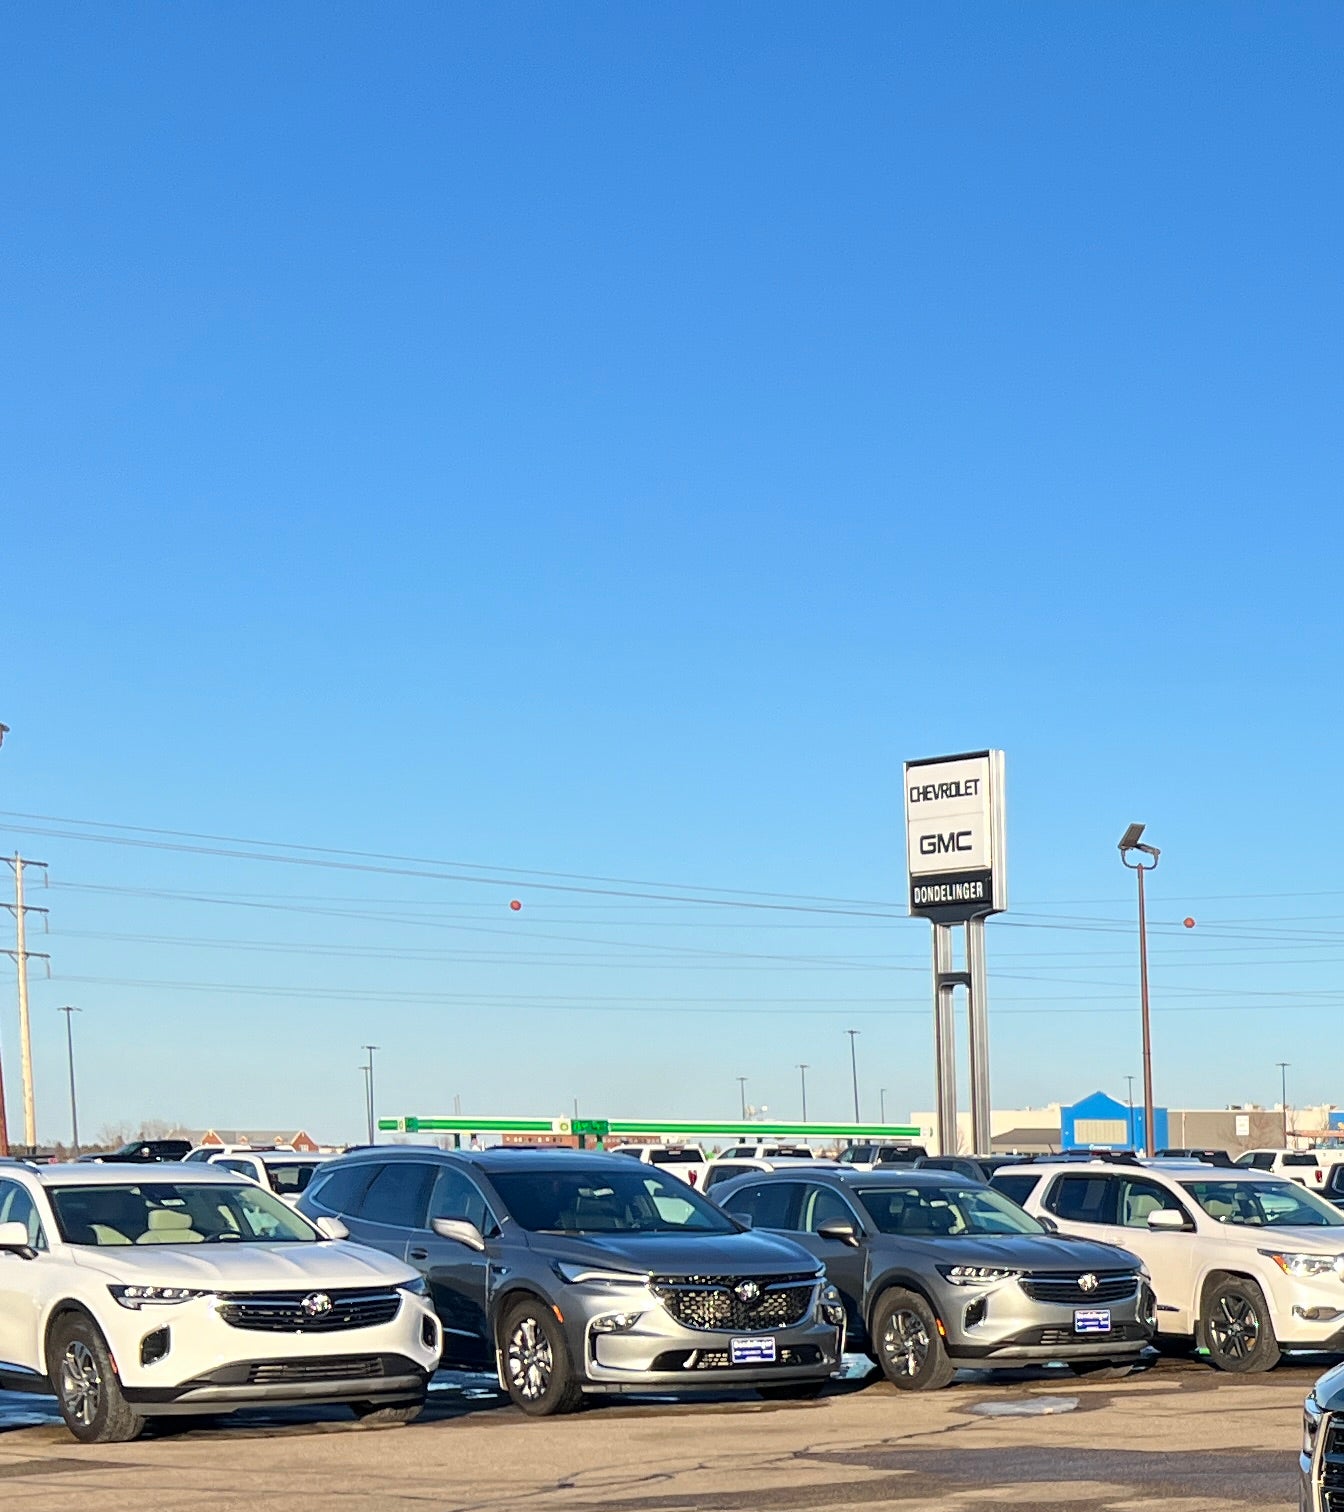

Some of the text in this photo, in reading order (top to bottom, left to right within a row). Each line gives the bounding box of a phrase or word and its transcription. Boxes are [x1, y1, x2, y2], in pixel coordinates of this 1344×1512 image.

[910, 779, 980, 803] CHEVROLET
[920, 830, 972, 855] GMC
[914, 881, 983, 904] DONDELINGER
